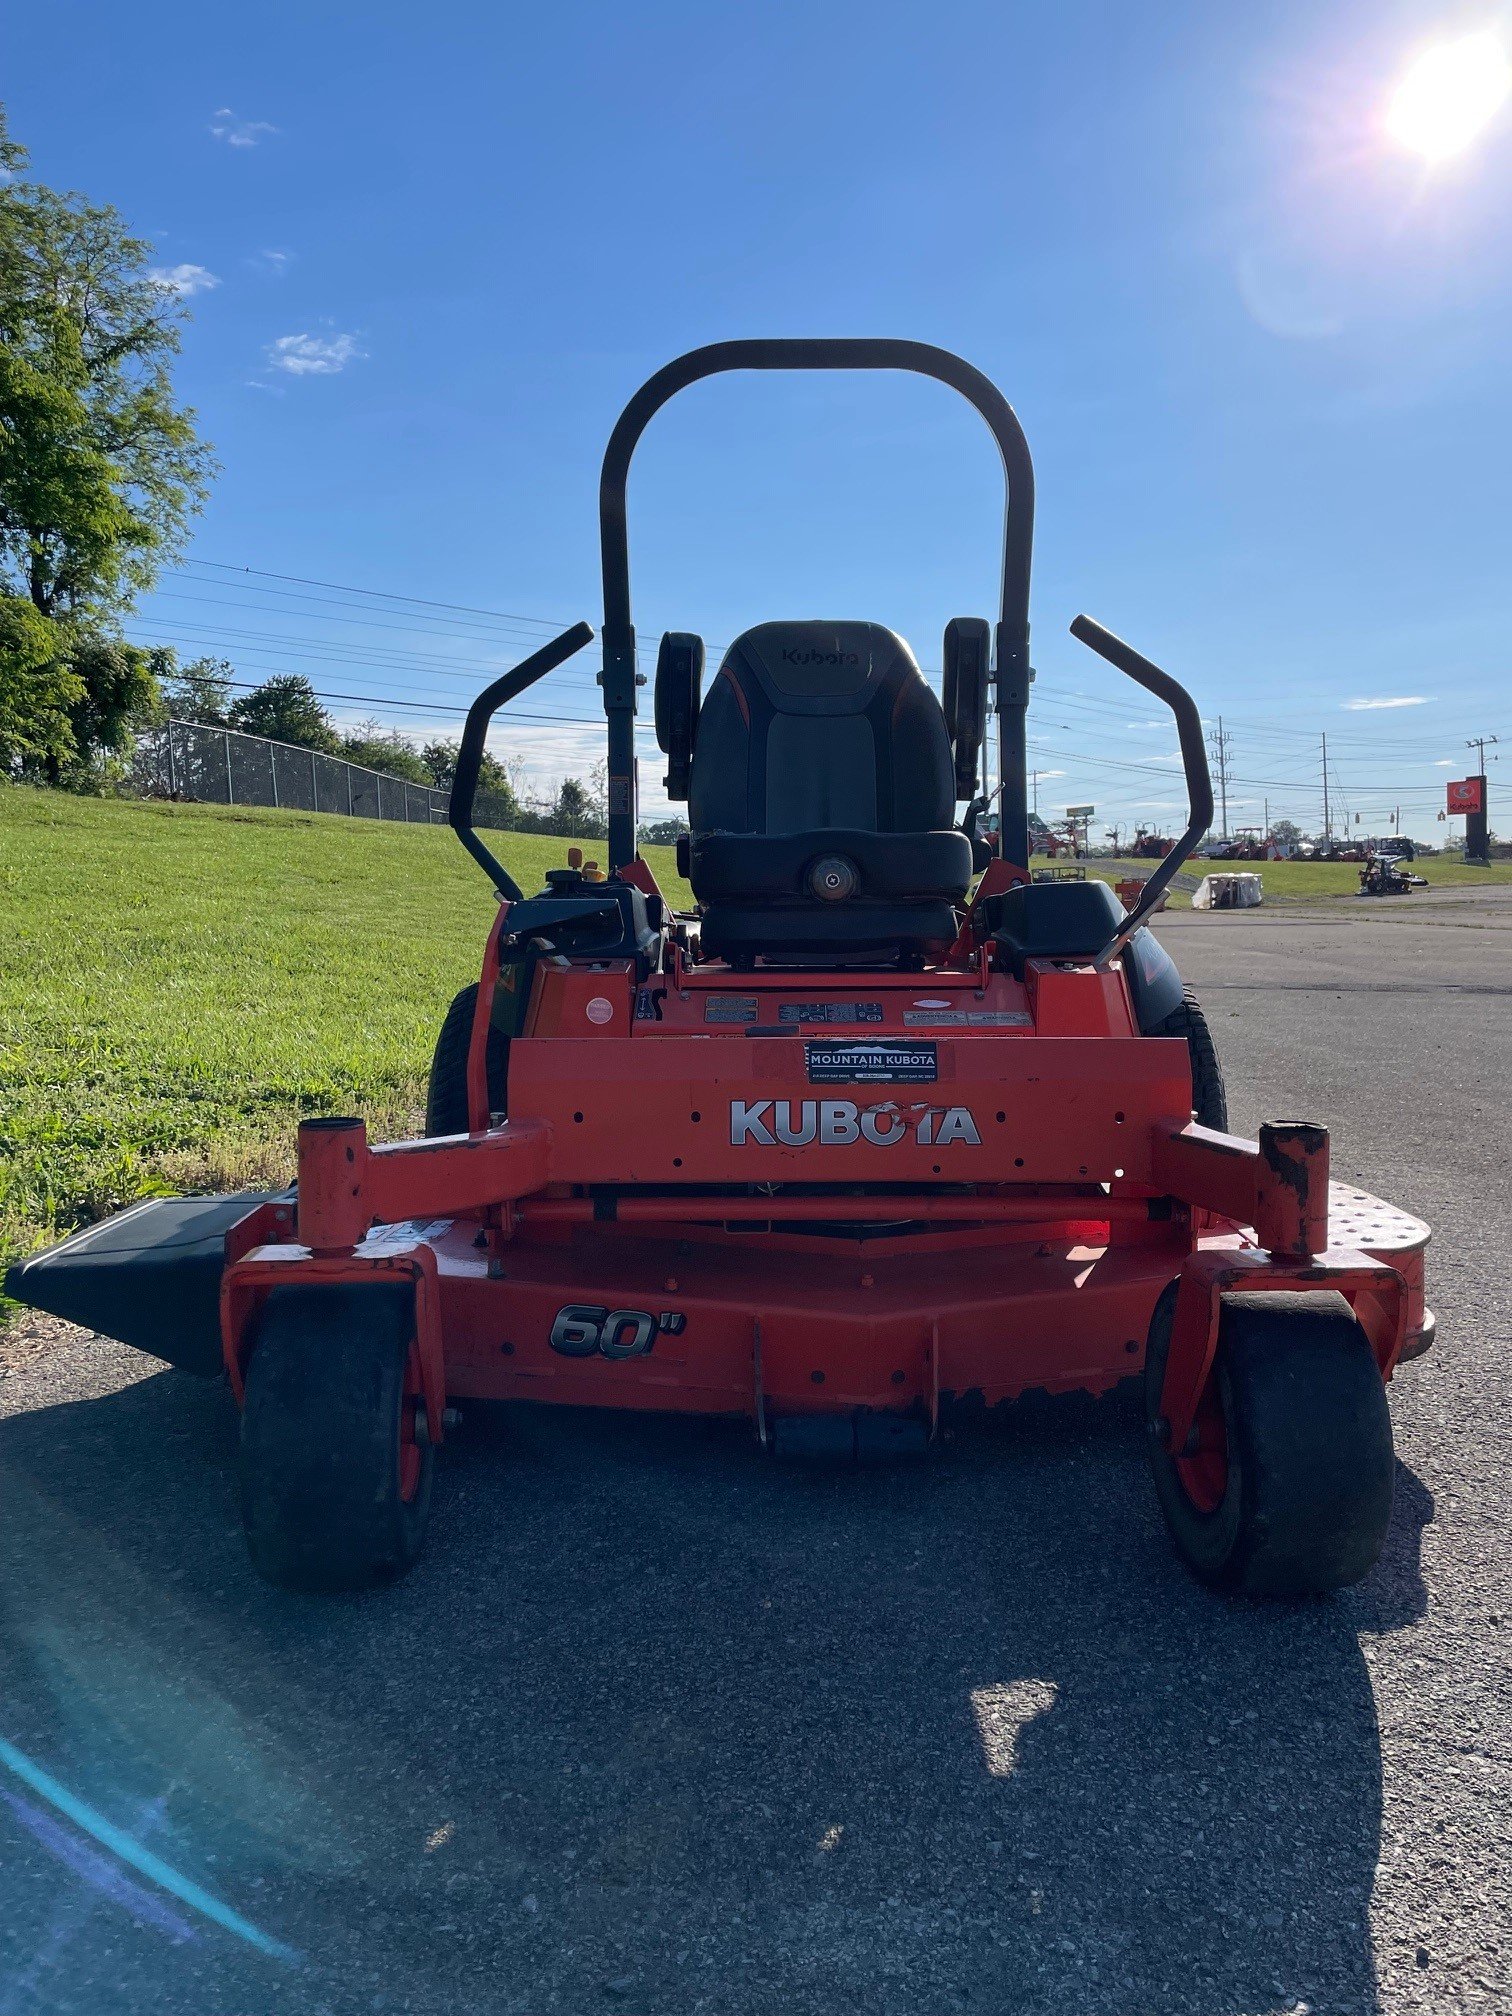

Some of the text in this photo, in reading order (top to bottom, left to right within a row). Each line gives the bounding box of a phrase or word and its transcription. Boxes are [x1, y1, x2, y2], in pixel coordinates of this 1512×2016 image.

[782, 648, 859, 666] Kubota
[811, 1055, 935, 1065] MOUNTAIN KUBOTA
[550, 1304, 686, 1359] 60"
